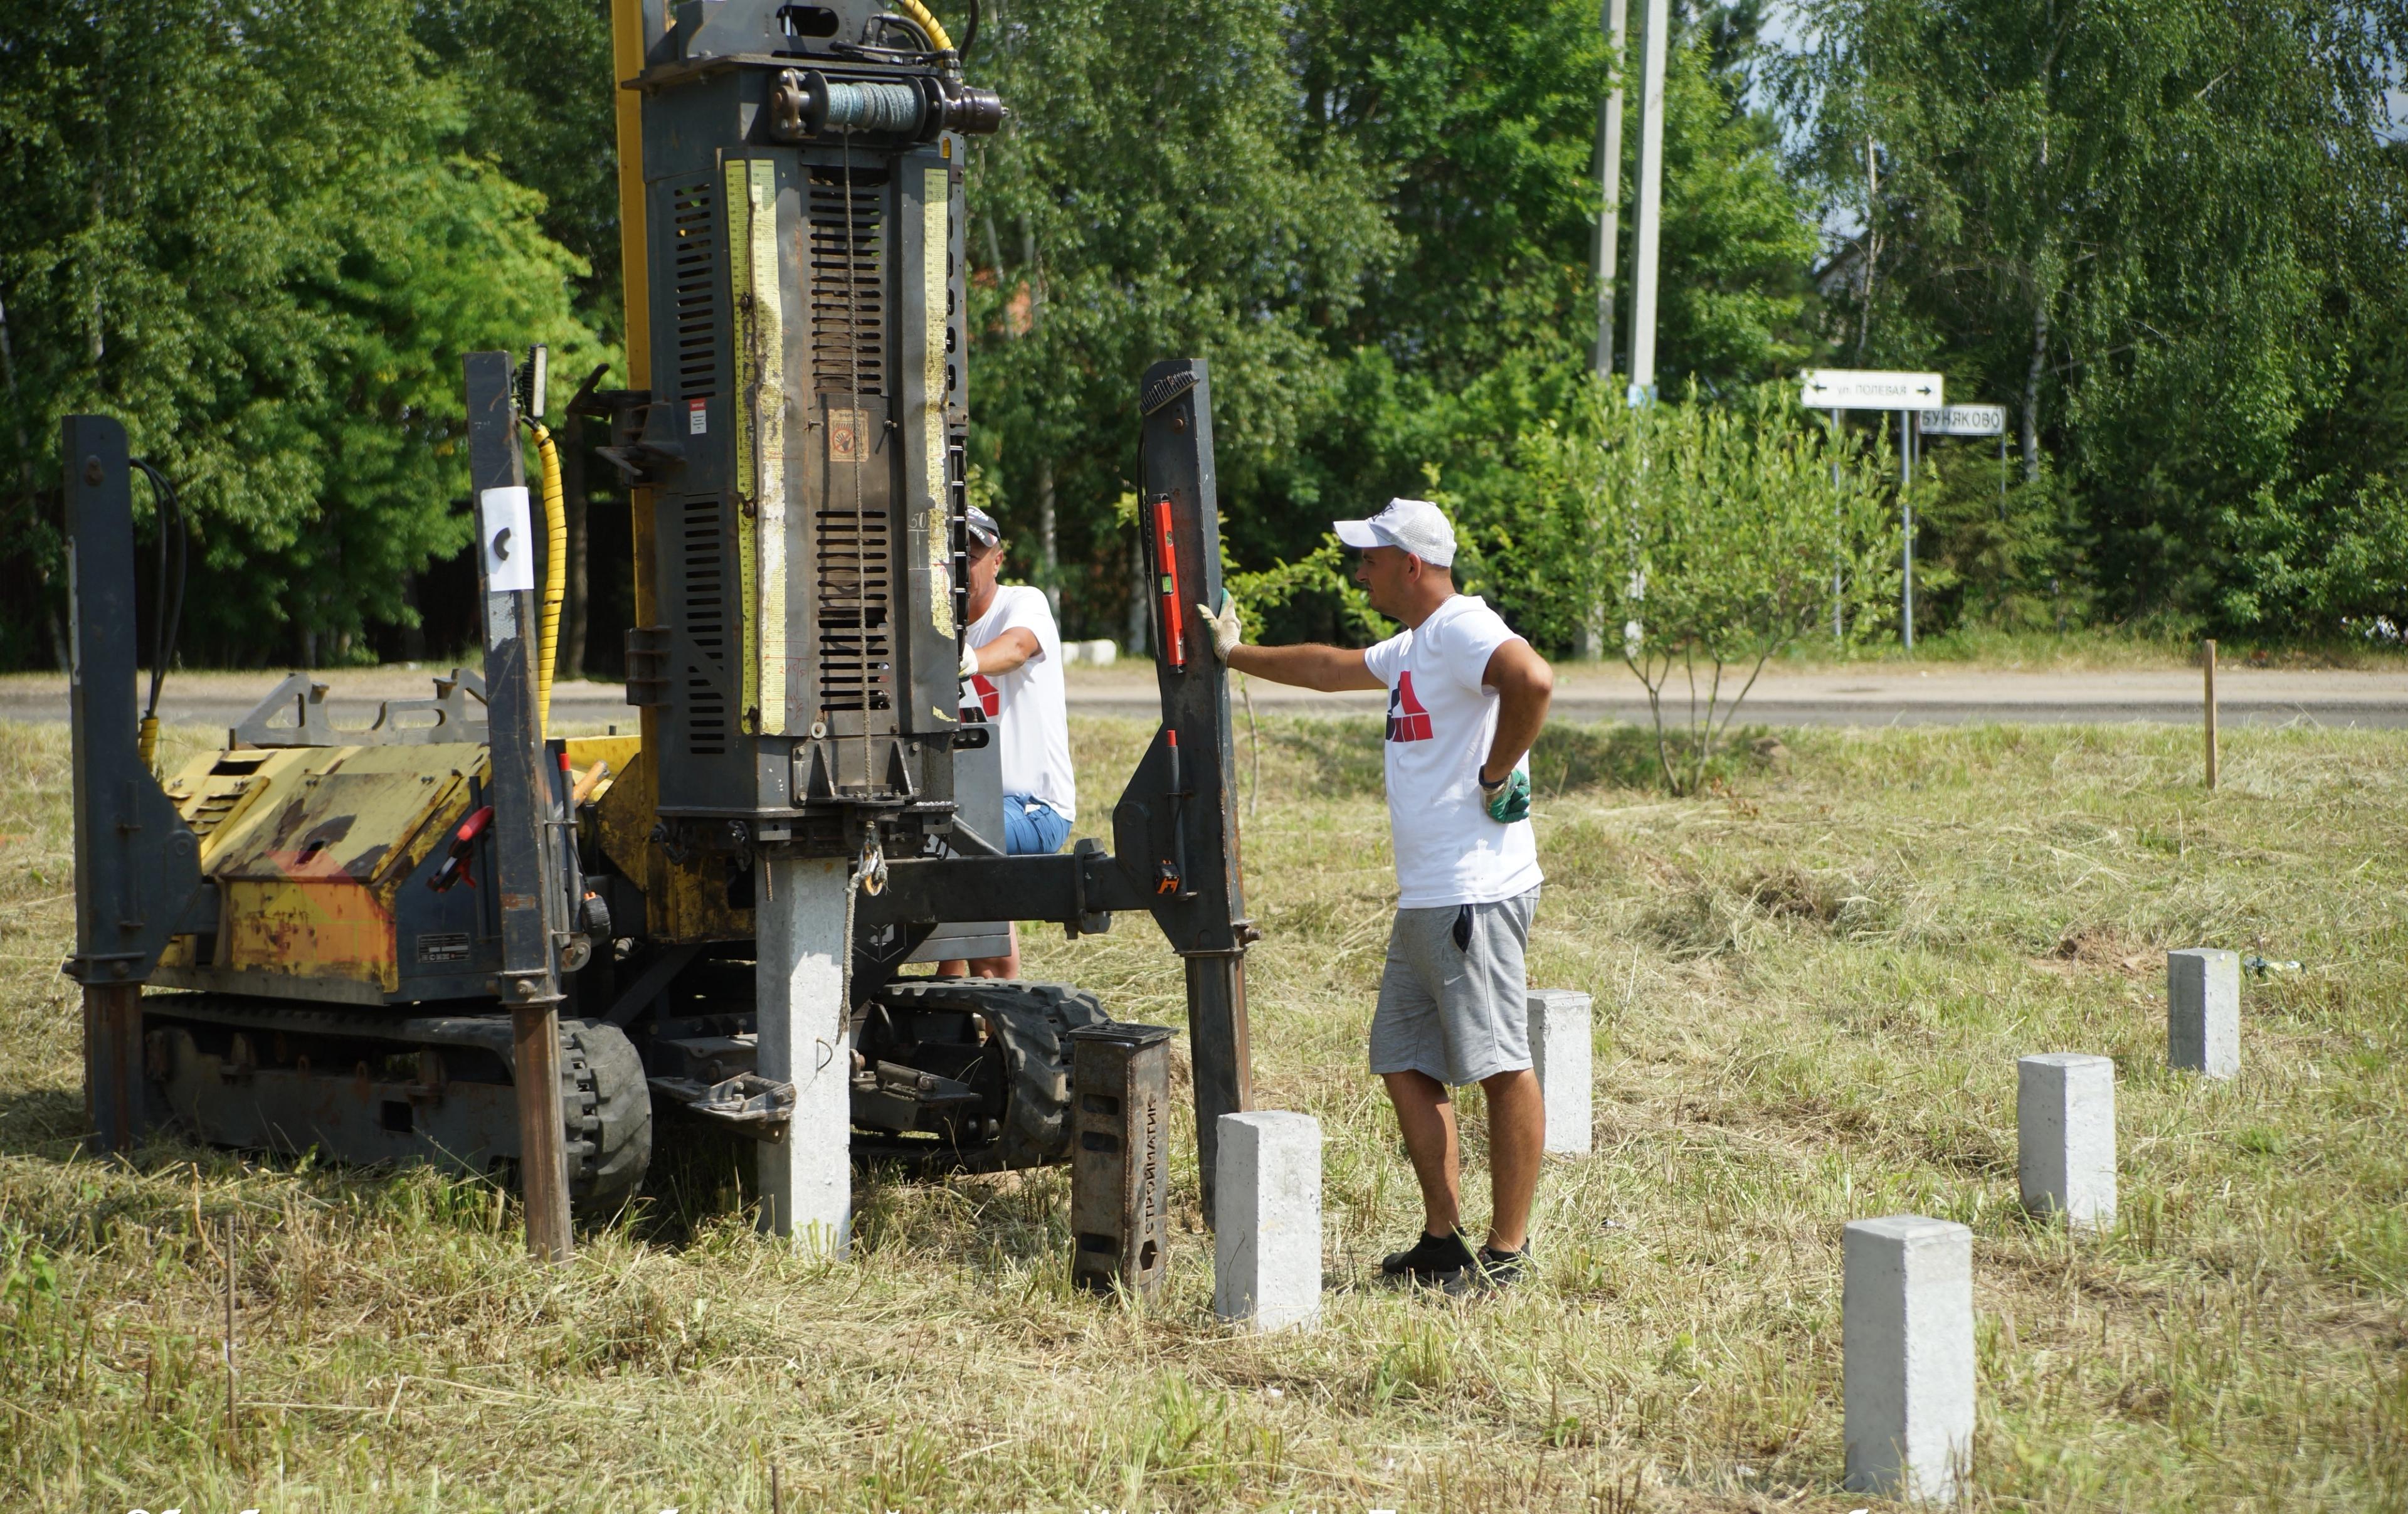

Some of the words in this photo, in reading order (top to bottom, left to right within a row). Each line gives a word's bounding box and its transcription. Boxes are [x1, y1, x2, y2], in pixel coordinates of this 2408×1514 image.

[1856, 384, 1907, 396] ПОЛЕВАЯ
[1921, 411, 2000, 428] БУНЯКОВО
[909, 512, 927, 529] 50
[1145, 1098, 1158, 1235] СТРОЙМАТИК
